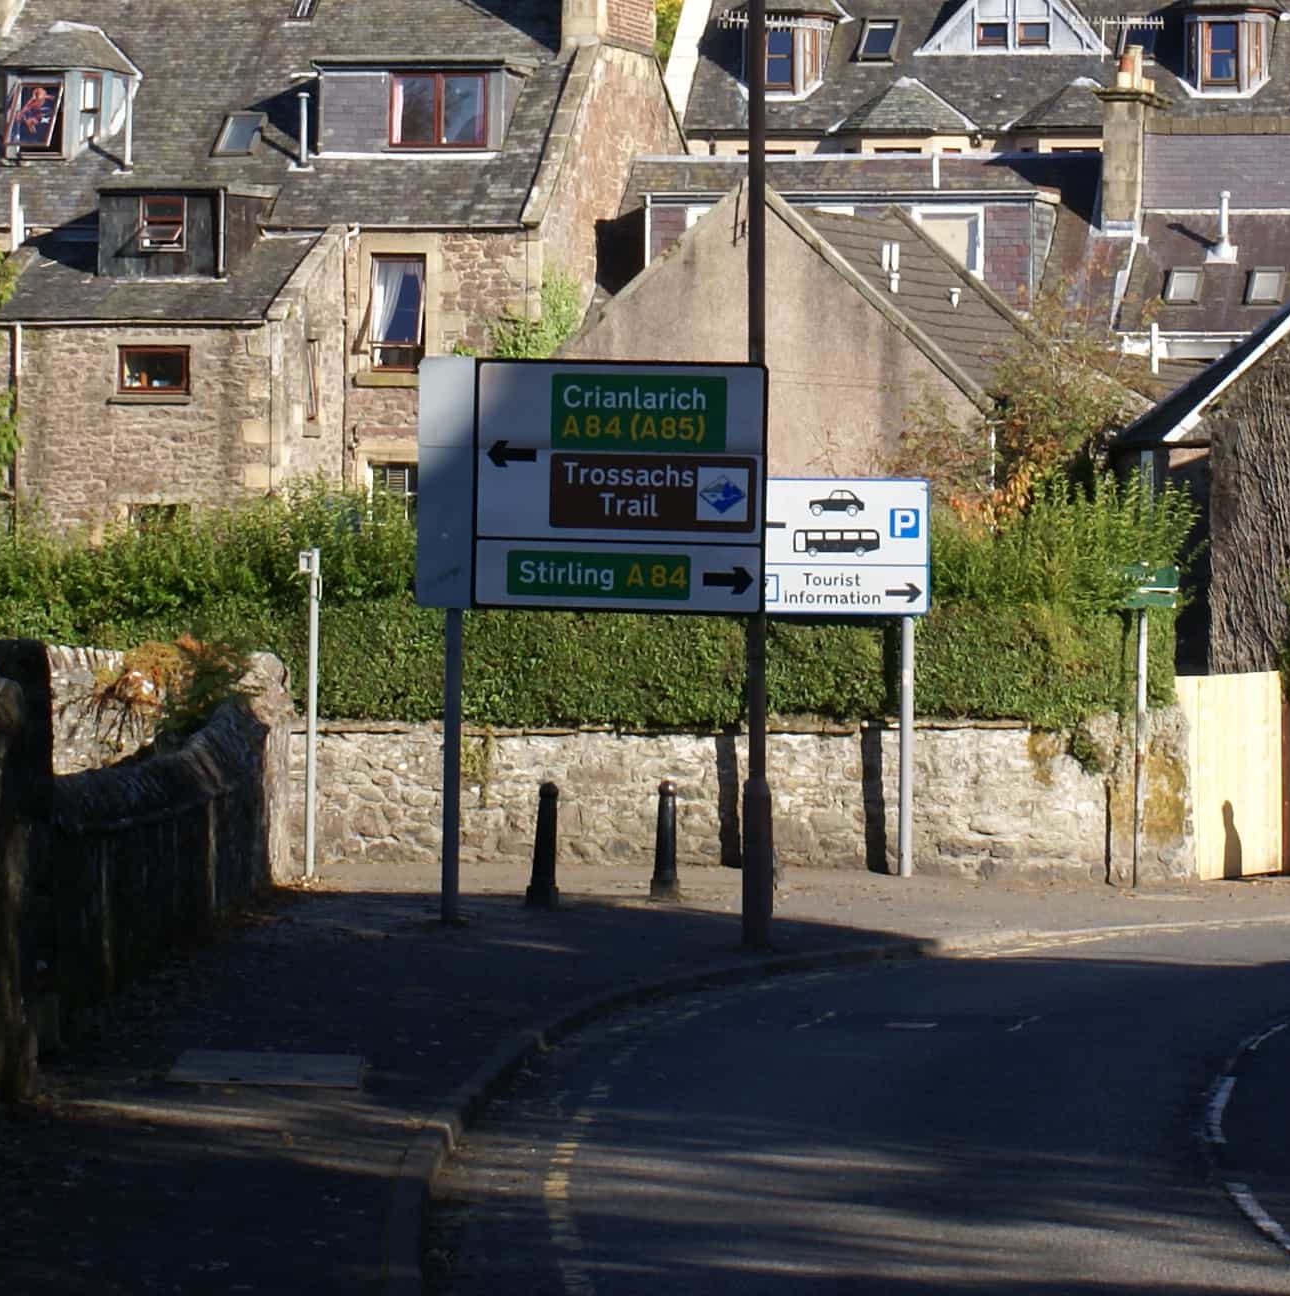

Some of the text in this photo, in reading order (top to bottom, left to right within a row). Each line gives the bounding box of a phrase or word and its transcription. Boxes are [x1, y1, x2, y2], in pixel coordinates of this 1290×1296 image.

[563, 385, 706, 411] Crianlarich
[562, 414, 706, 442] A84 (A85)
[564, 462, 693, 488] Trossachs
[600, 493, 660, 517] Trail
[894, 511, 916, 536] P
[519, 560, 686, 591] Stirling A84
[802, 572, 861, 586] Tourist
